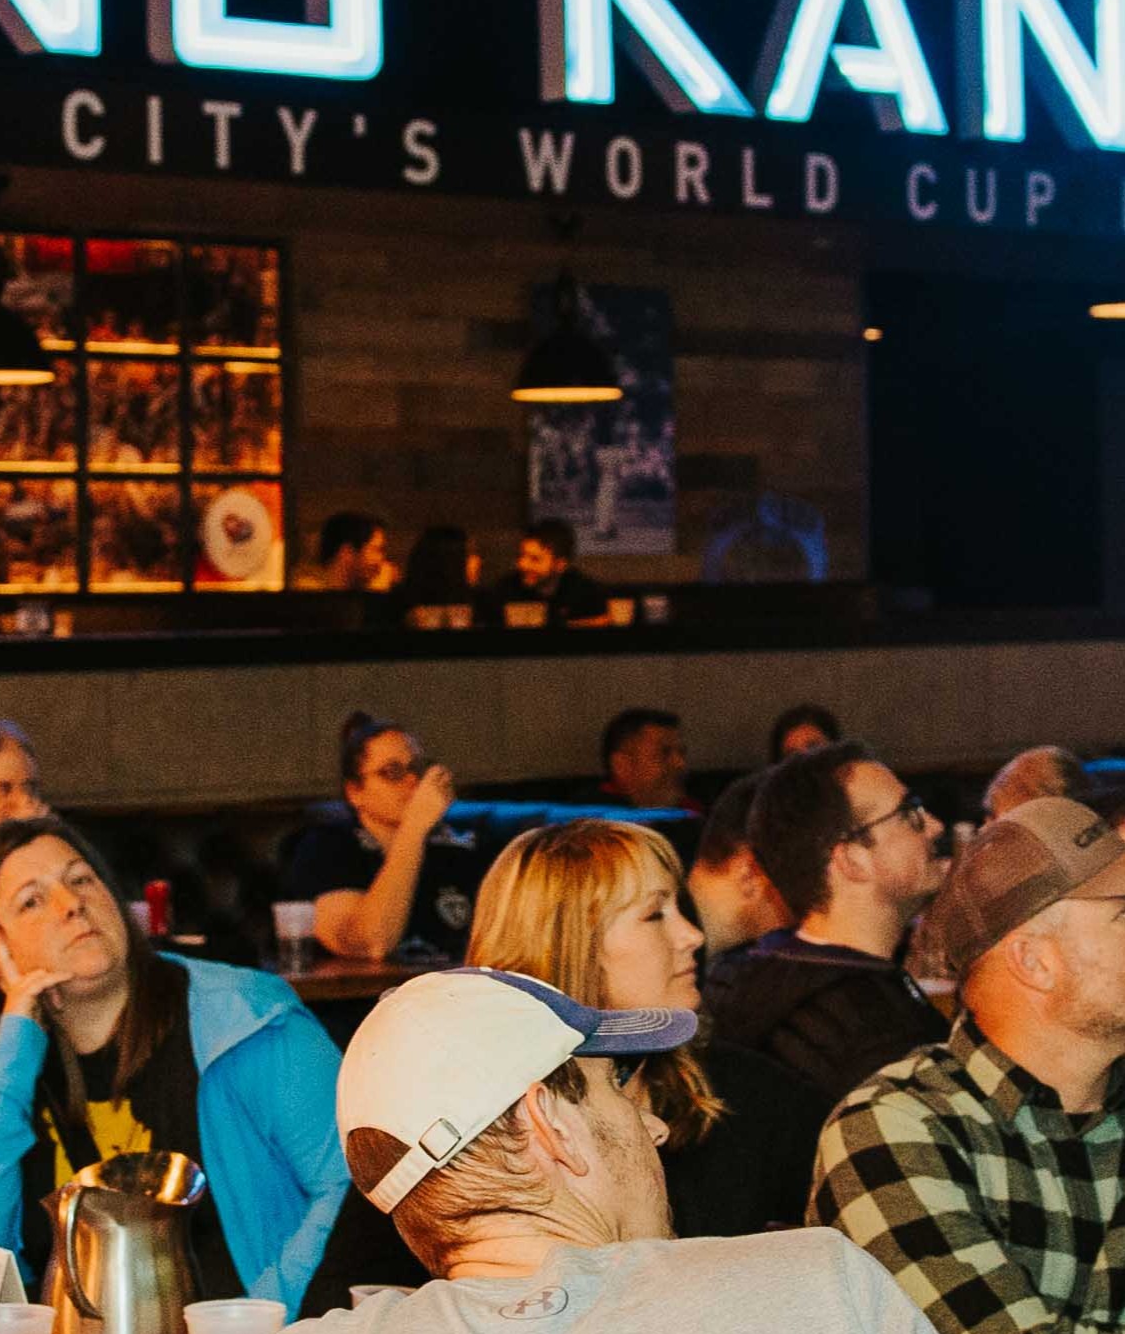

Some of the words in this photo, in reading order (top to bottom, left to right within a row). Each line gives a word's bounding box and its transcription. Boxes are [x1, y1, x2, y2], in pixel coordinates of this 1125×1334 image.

[61, 87, 442, 185] CITY'S
[519, 127, 840, 214] WORLD
[906, 162, 1056, 227] CUP
